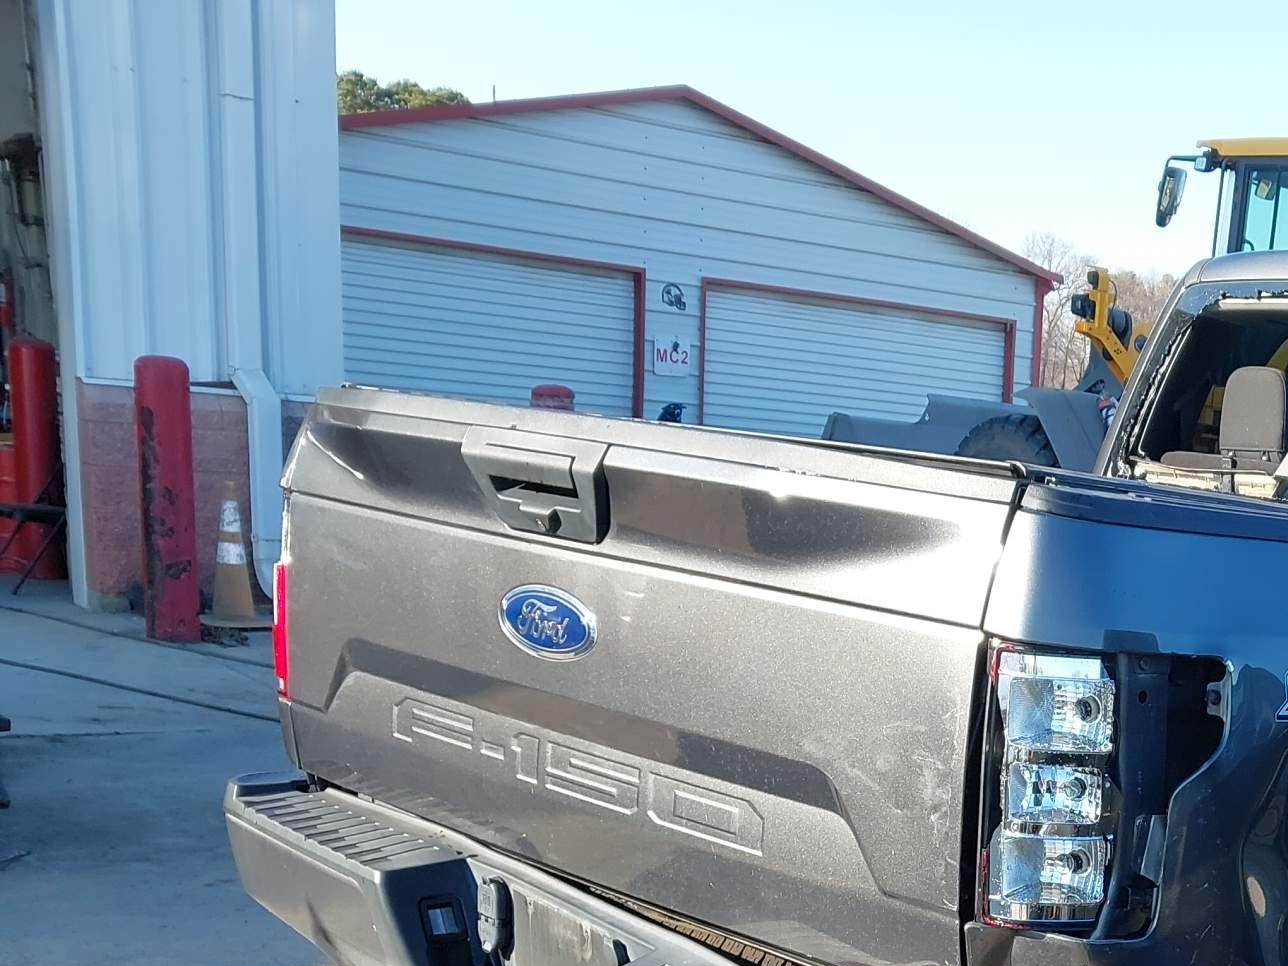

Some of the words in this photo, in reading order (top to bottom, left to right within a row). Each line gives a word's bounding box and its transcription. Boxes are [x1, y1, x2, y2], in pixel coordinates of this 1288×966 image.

[656, 346, 689, 365] MC2
[517, 598, 569, 645] Ford
[392, 697, 765, 856] F-150
